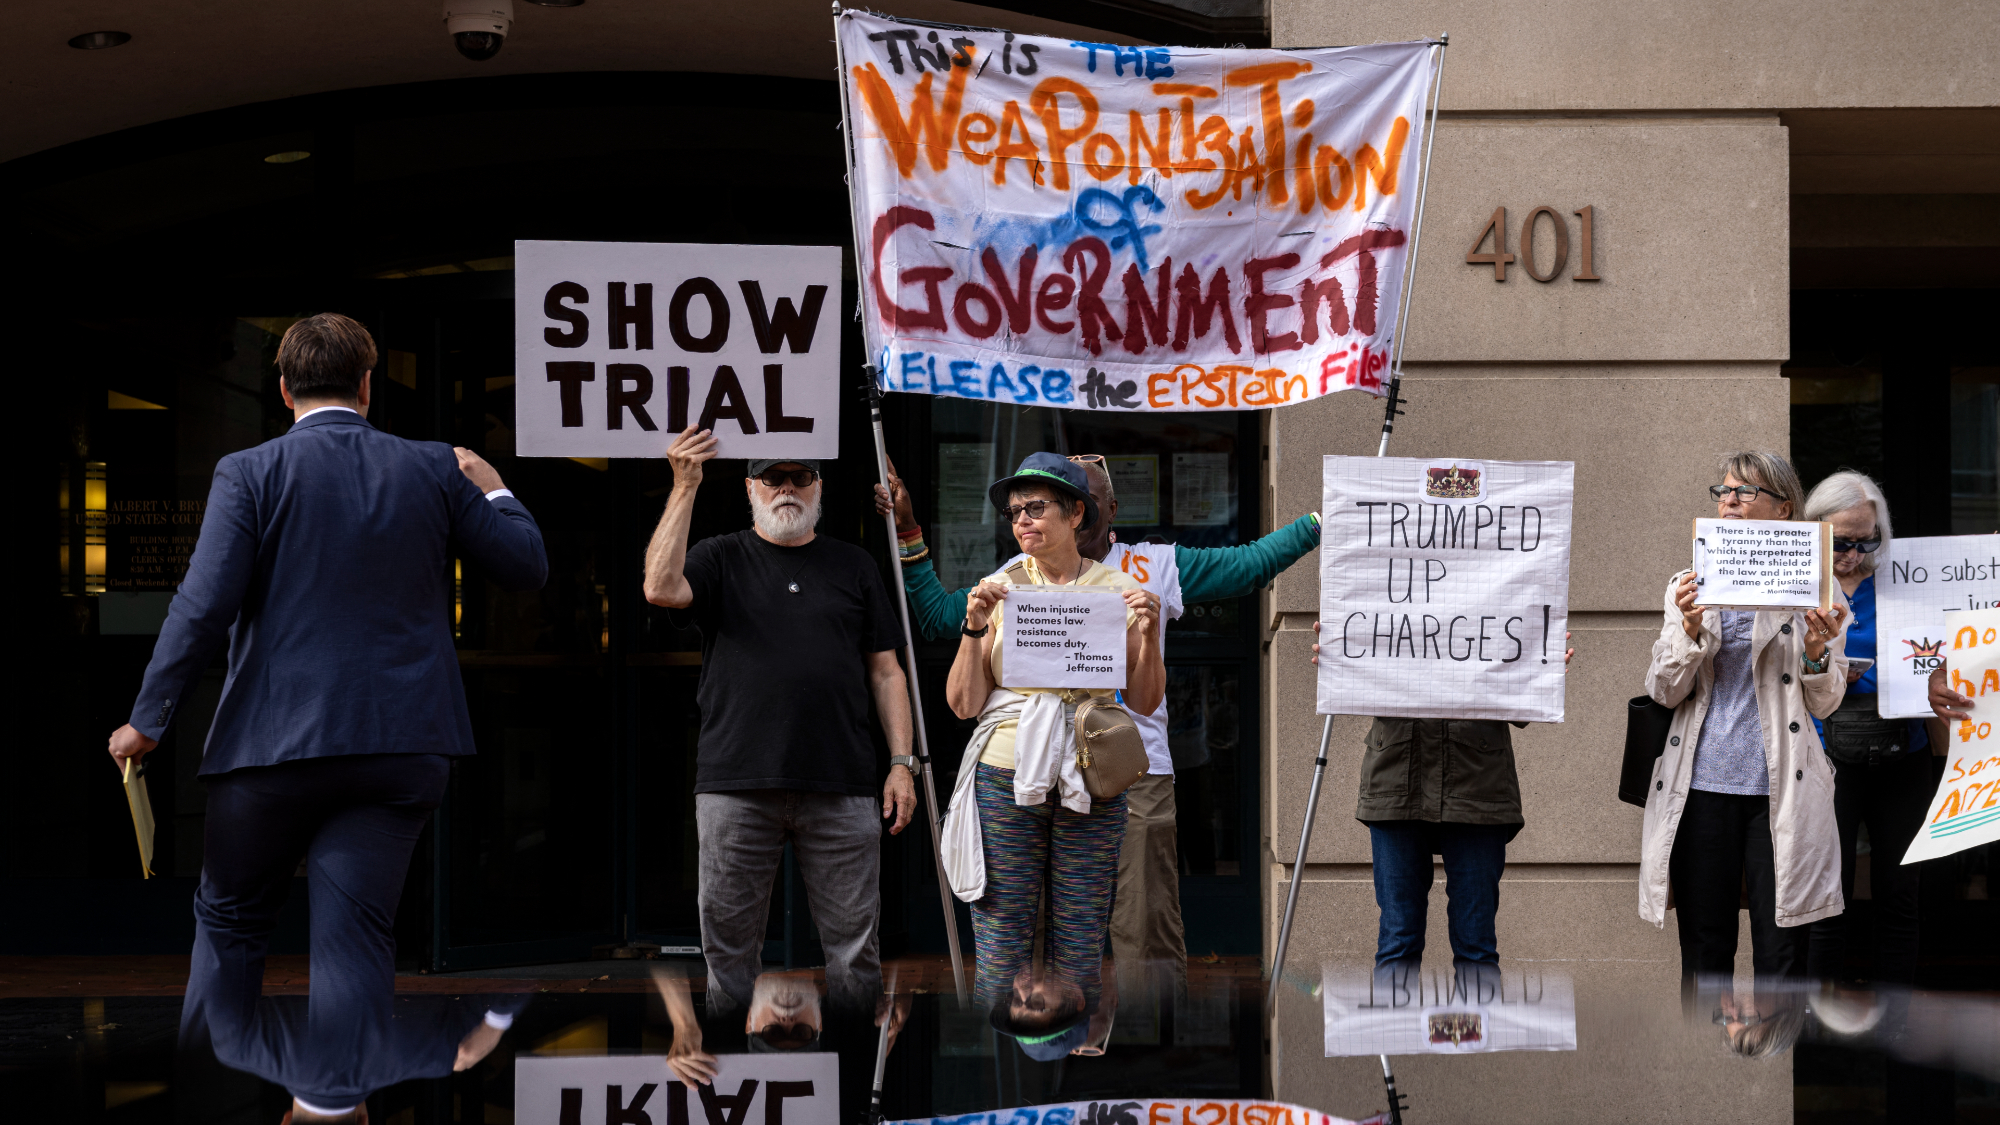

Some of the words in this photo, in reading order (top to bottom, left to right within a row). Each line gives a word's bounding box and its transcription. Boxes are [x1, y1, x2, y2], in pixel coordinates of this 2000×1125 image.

[868, 29, 974, 74] This
[1002, 32, 1040, 76] is
[1070, 41, 1175, 80] THE
[1466, 205, 1601, 282] 401
[544, 277, 828, 353] SHOW
[1079, 367, 1142, 409] the
[545, 361, 815, 434] TRIAL
[111, 500, 158, 512] ALBERT
[162, 500, 174, 512] V.
[75, 513, 121, 525] UNITED
[125, 513, 167, 525] STATES
[1356, 502, 1541, 552] TRUMPED
[1716, 526, 1744, 535] There
[1747, 527, 1755, 535] is
[1773, 529, 1811, 538] greater
[129, 536, 168, 544] BUILDING
[1722, 538, 1762, 547] tyranny
[1765, 538, 1788, 546] than
[1791, 539, 1811, 547] that
[1707, 547, 1736, 555] which
[1740, 547, 1747, 555] is
[1750, 548, 1811, 557] perpetrated
[131, 556, 164, 564] CLERK'S
[1716, 557, 1746, 565] under
[1749, 558, 1765, 566] the
[1768, 558, 1798, 567] shield
[1801, 559, 1812, 567] of
[1719, 567, 1734, 575] the
[1738, 568, 1757, 576] law
[1760, 568, 1780, 577] and
[1795, 568, 1811, 576] the
[1892, 560, 1928, 584] No
[110, 578, 132, 587] Closed
[136, 578, 168, 587] Weekends
[1388, 558, 1447, 603] UP
[1764, 578, 1774, 586] of
[1777, 578, 1811, 587] justice.
[1017, 604, 1047, 613] When
[1049, 604, 1091, 616] injustice
[1017, 616, 1061, 625] becomes
[1016, 627, 1067, 636] resistance
[1016, 639, 1061, 648] becomes
[1074, 652, 1113, 661] Thomas
[1066, 663, 1113, 673] Jefferson
[1913, 658, 1940, 670] NO
[1957, 717, 1991, 742] to
